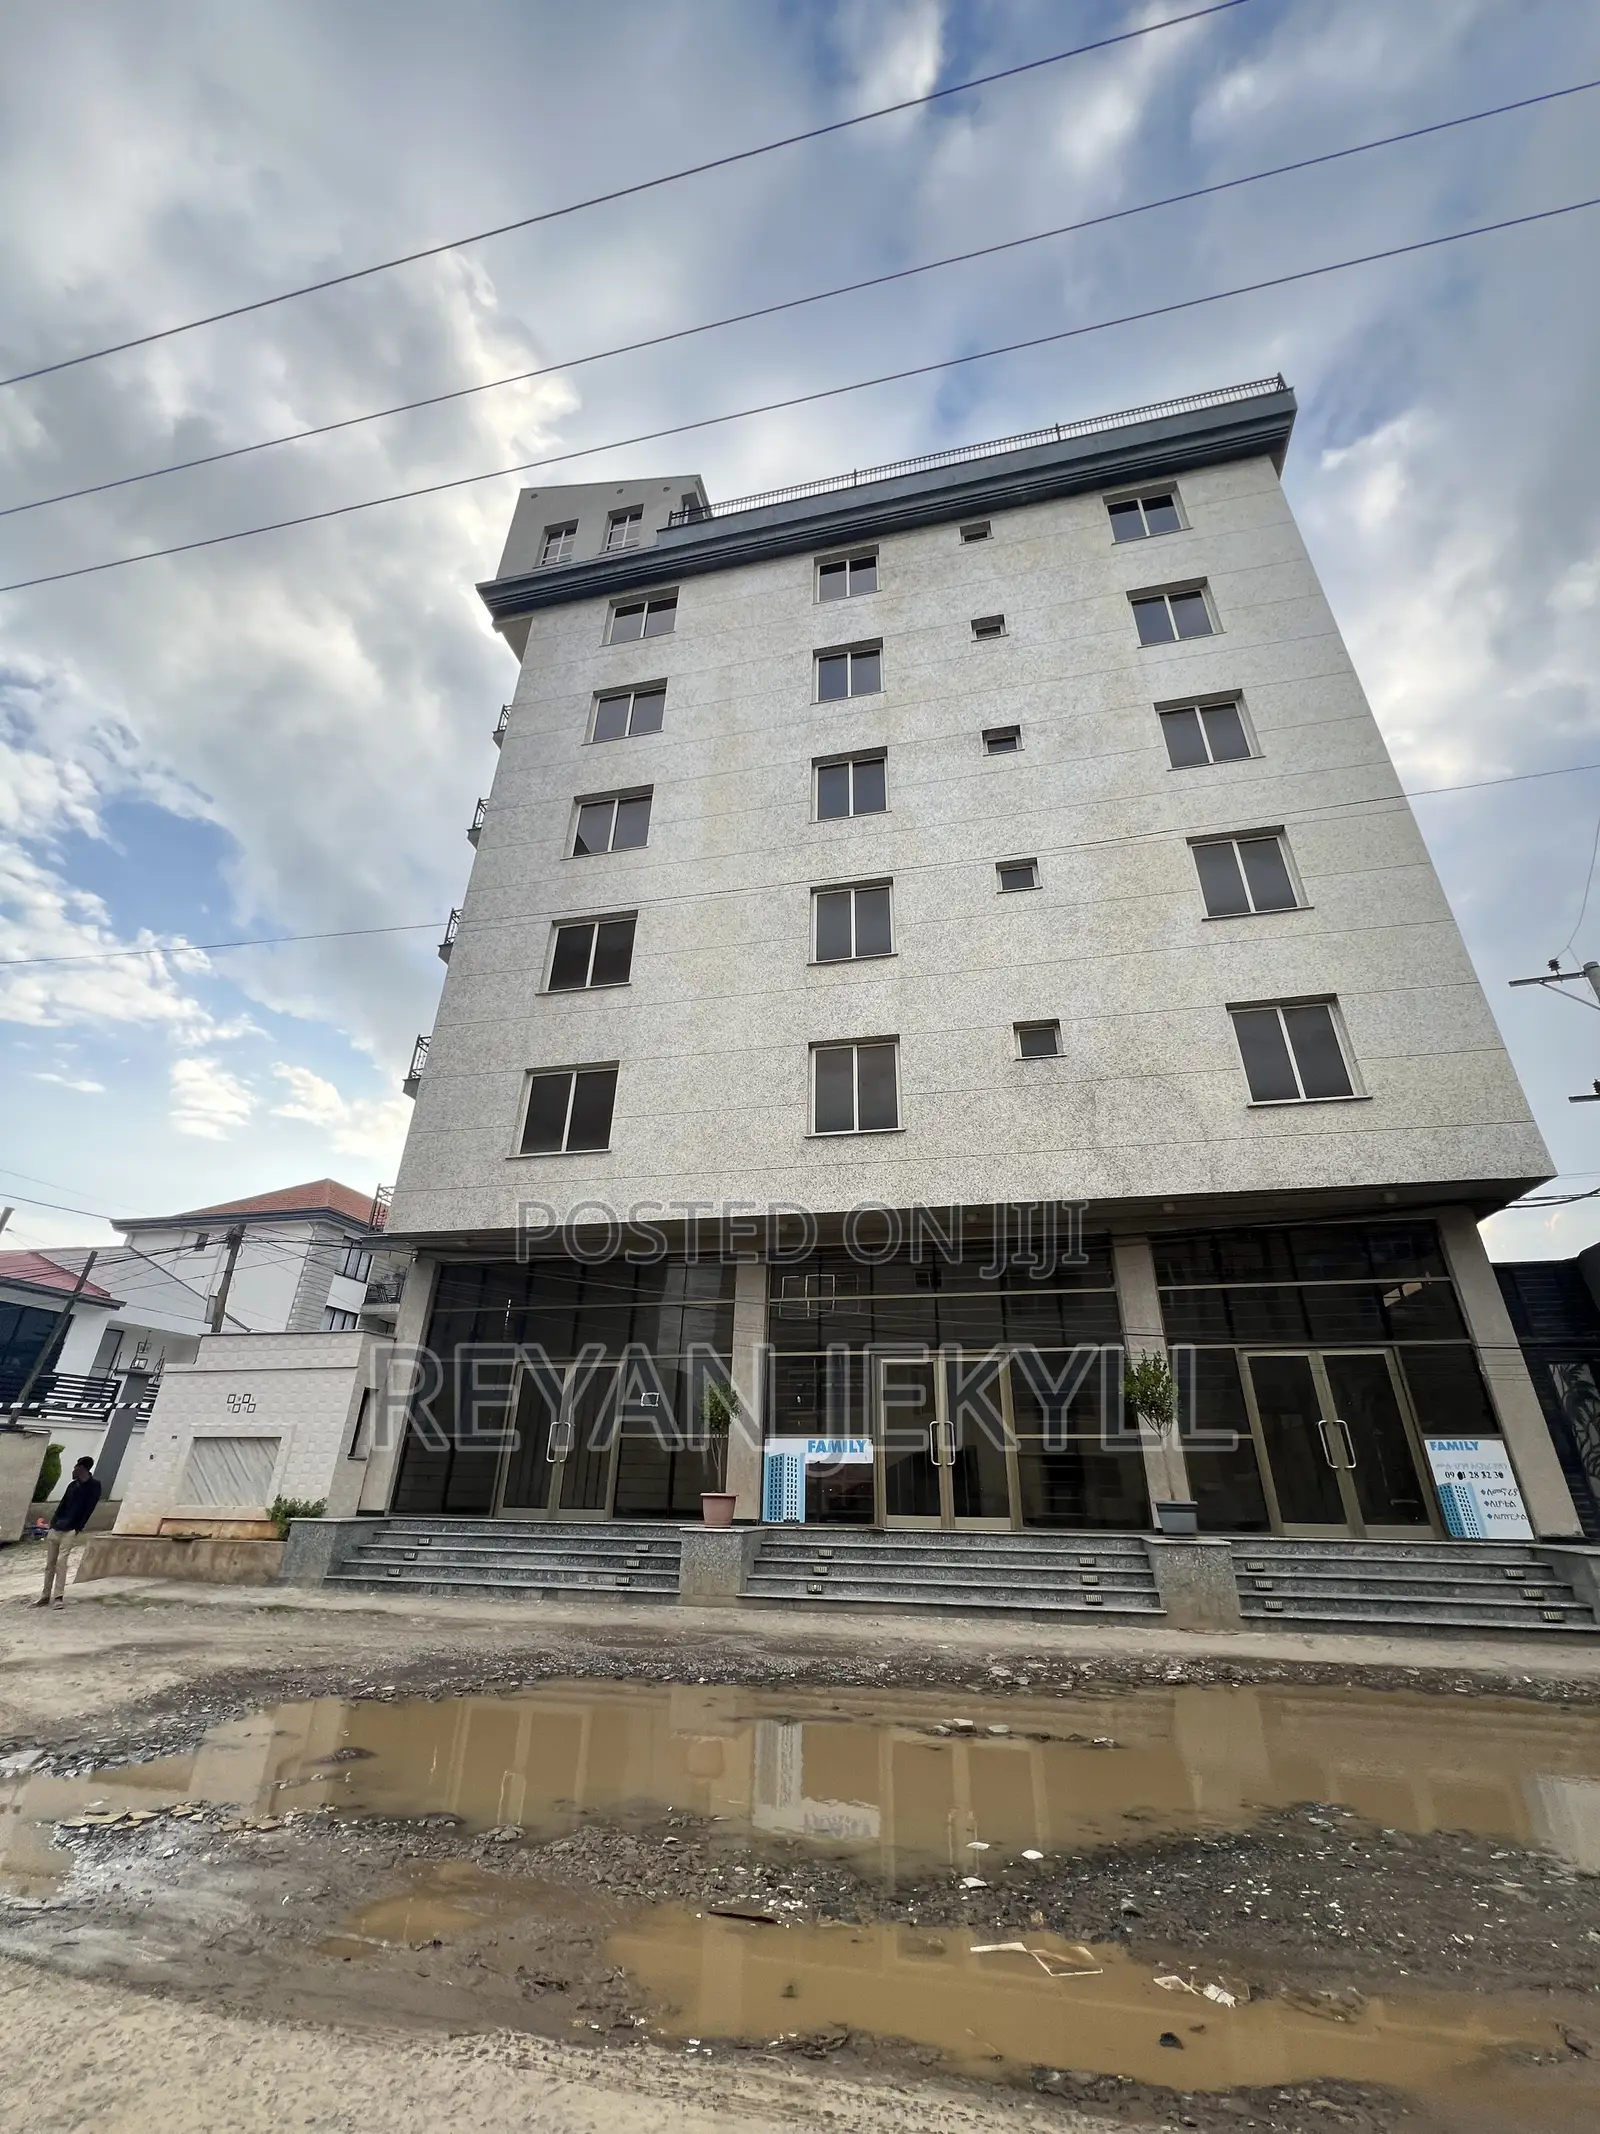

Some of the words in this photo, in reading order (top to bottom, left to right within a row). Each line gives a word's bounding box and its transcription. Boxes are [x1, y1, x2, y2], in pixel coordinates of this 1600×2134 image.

[808, 1440, 867, 1453] FAMILY
[1429, 1441, 1479, 1451] FAMILY
[1445, 1471, 1455, 1479] 09
[1468, 1471, 1479, 1479] 28
